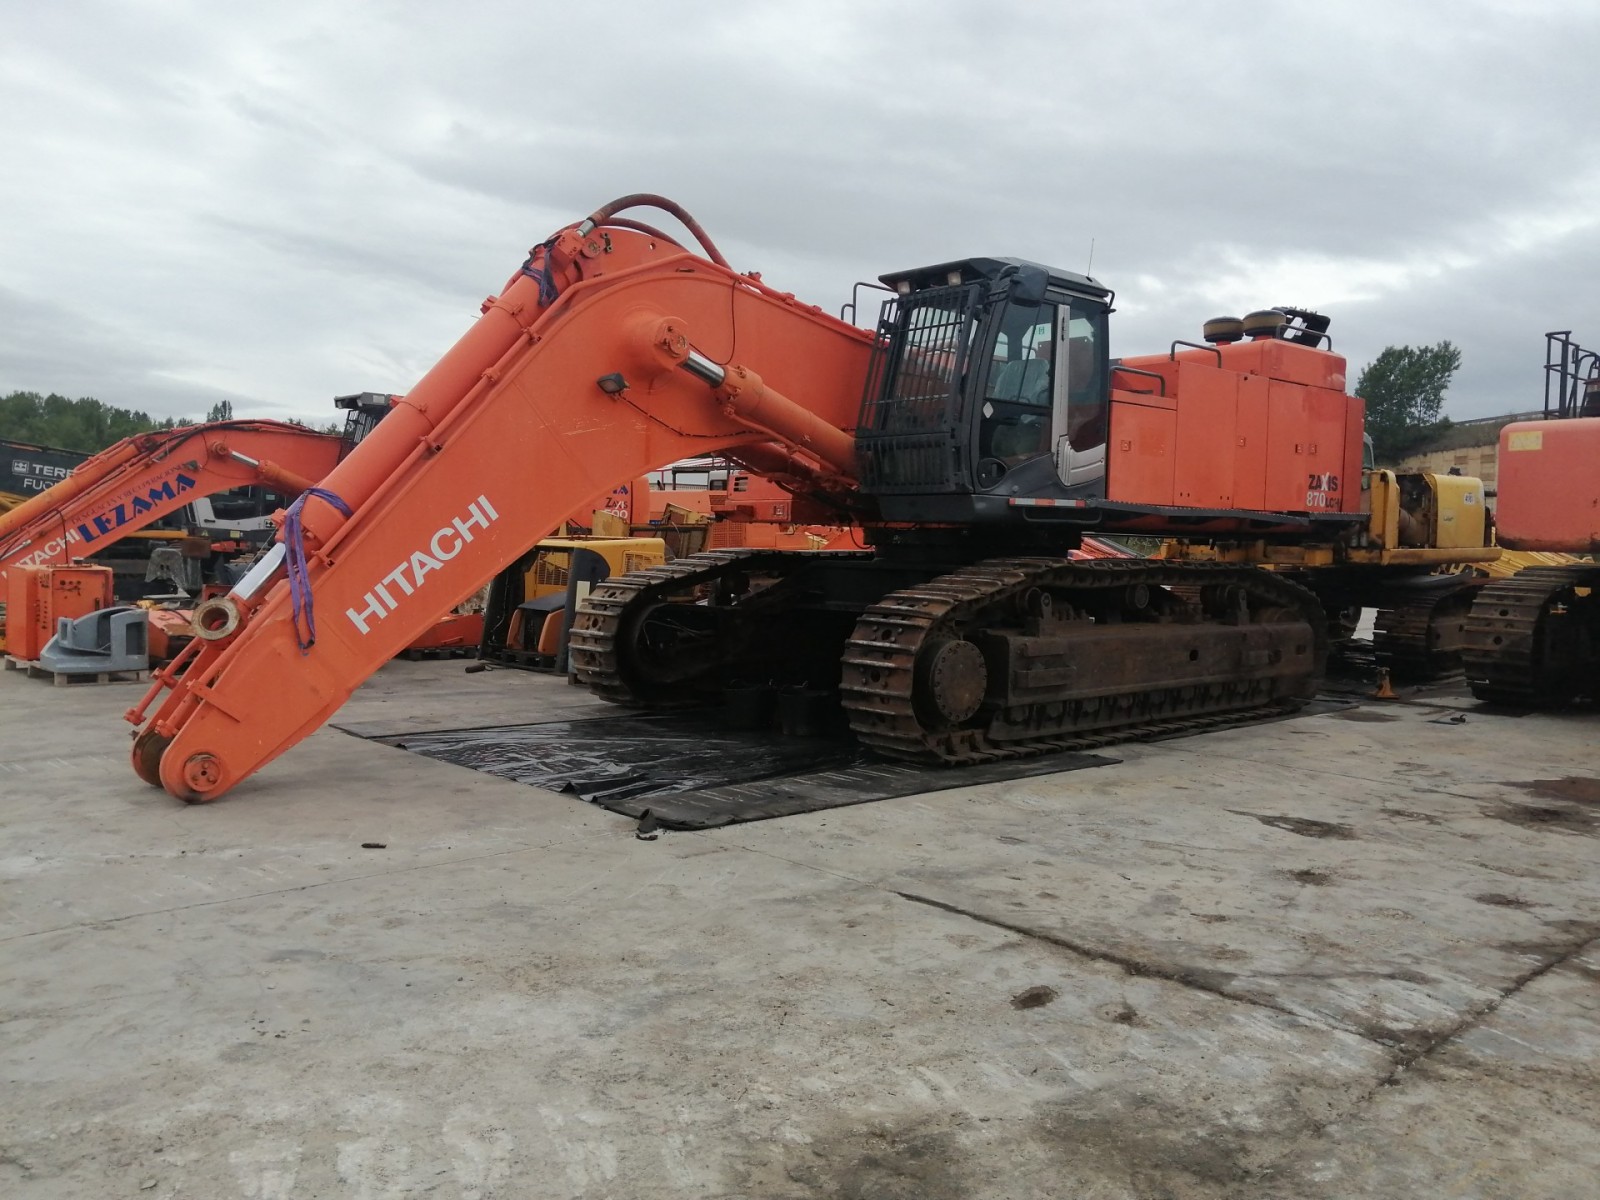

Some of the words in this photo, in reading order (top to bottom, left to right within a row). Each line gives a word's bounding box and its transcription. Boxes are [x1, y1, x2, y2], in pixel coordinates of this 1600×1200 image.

[32, 463, 77, 478] TERE
[1308, 471, 1338, 491] ZAXIS
[77, 473, 196, 543] LEZAMA
[345, 494, 499, 635] HITACHI
